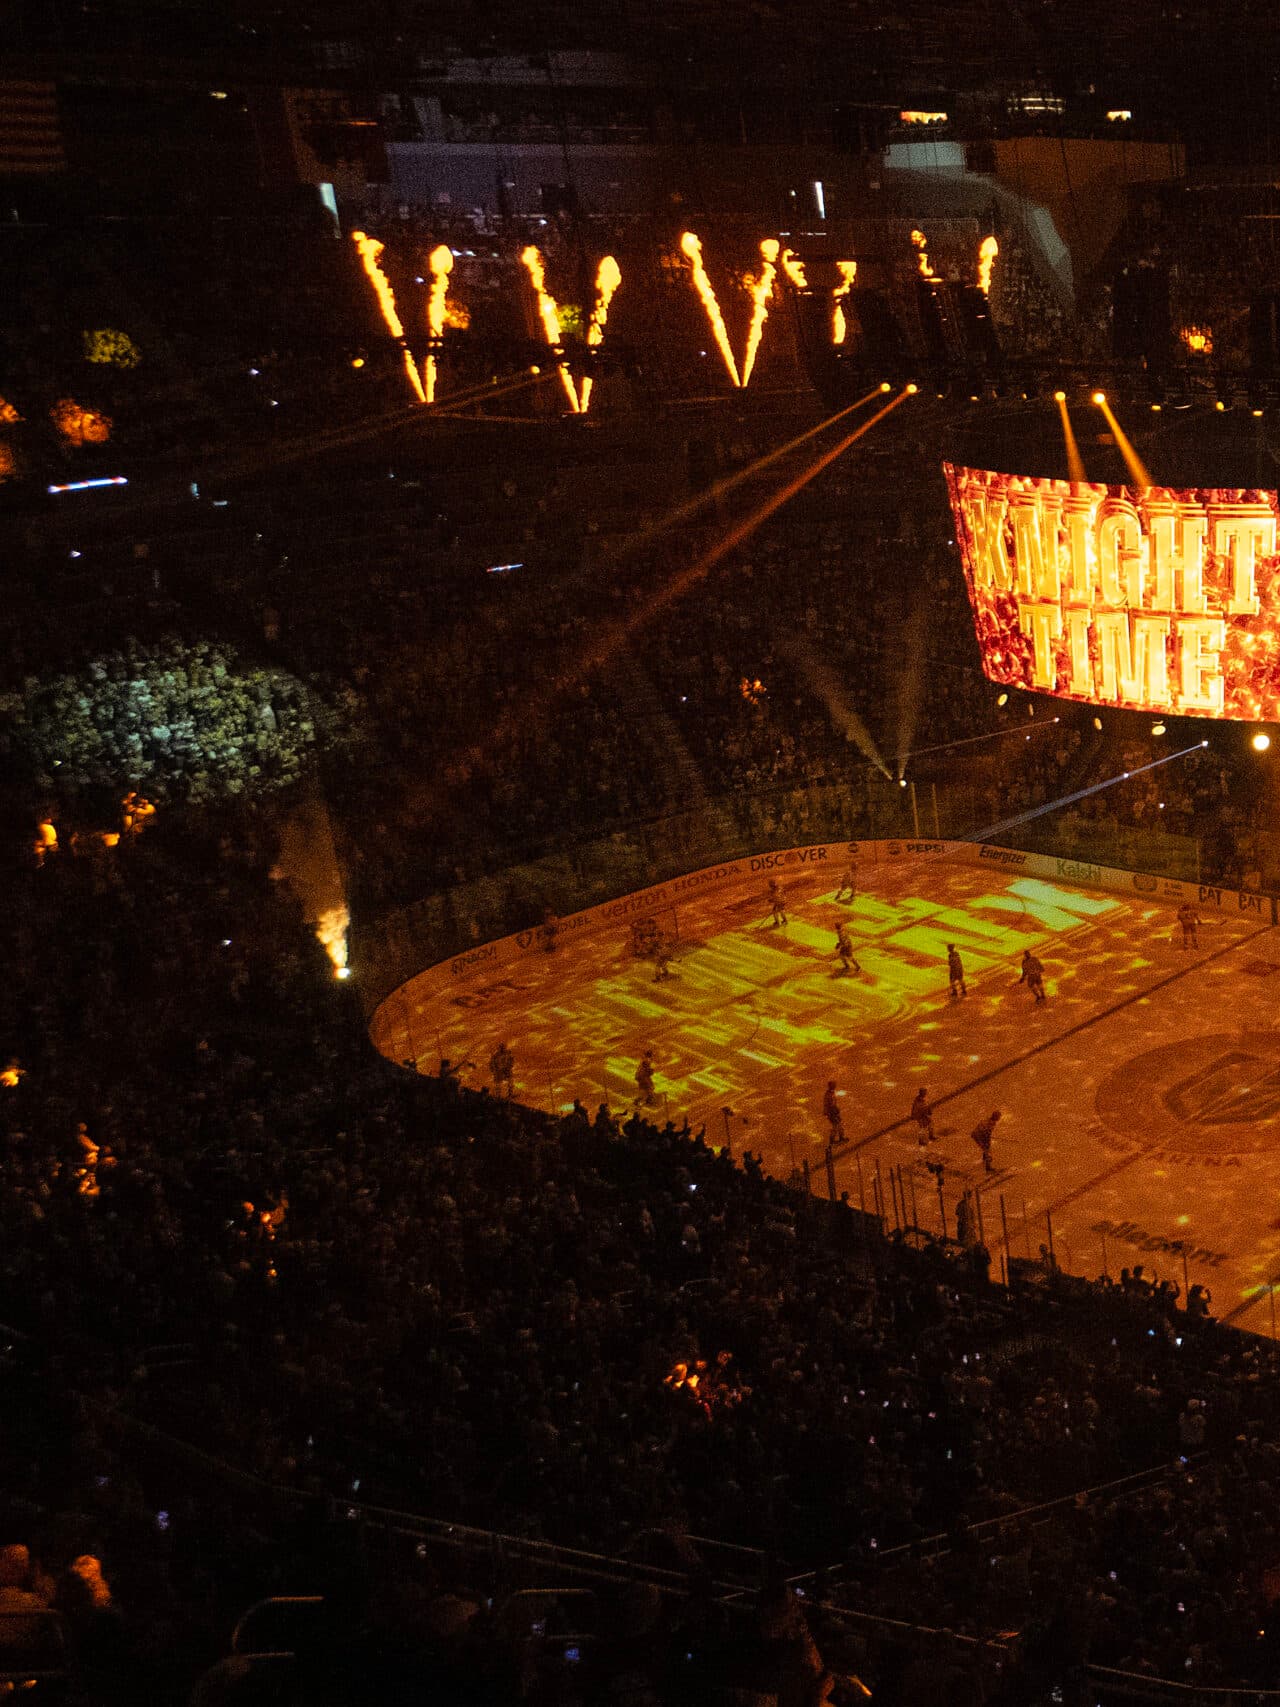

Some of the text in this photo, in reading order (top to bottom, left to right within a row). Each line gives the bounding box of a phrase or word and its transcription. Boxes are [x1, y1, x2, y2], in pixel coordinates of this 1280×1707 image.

[966, 490, 1278, 615] KNIGHT
[1018, 603, 1225, 713] TIME
[751, 847, 828, 872] DISCOVER
[906, 843, 946, 854] PEPSI
[978, 845, 1027, 866] Energizer
[674, 866, 742, 893] HONDA
[1056, 859, 1102, 884] Kalshi
[601, 888, 668, 920] verizon
[1198, 885, 1222, 907] CAT
[1238, 890, 1263, 914] CAT
[537, 916, 592, 942] FDUEL
